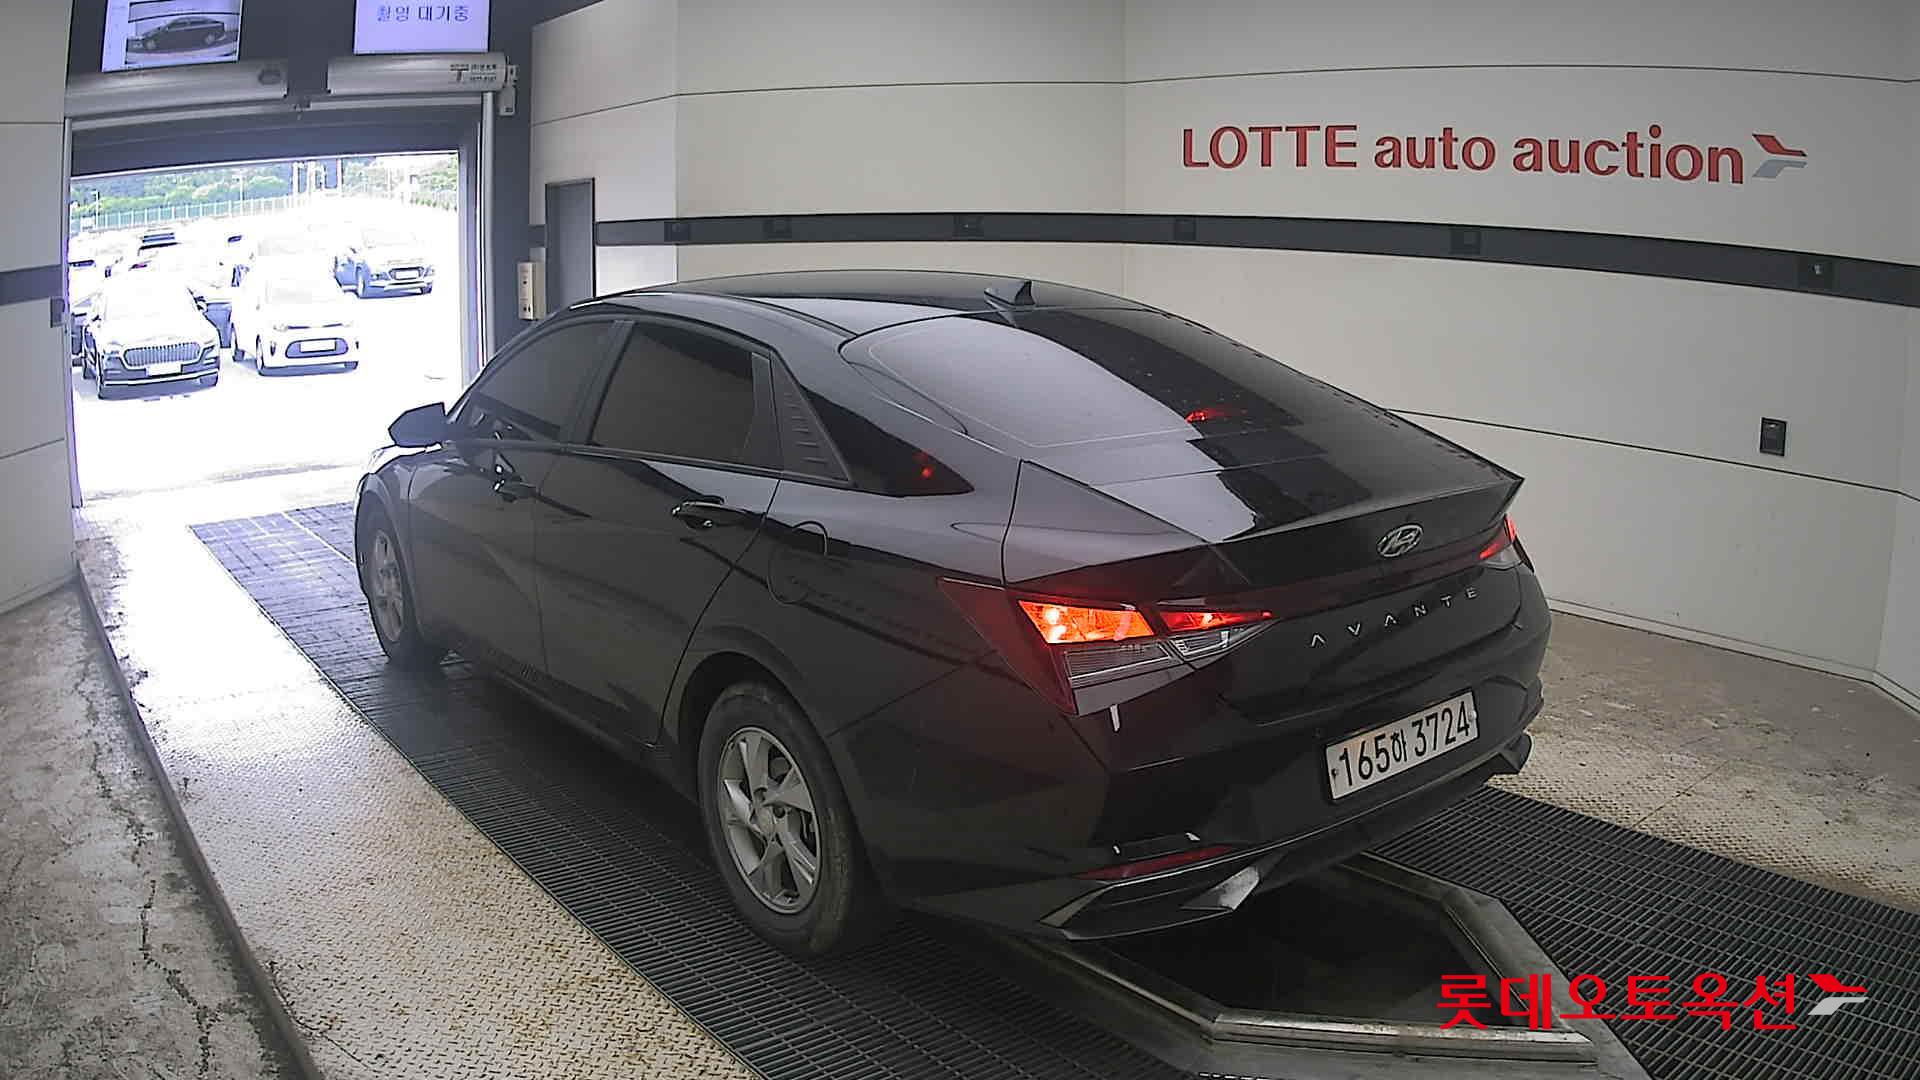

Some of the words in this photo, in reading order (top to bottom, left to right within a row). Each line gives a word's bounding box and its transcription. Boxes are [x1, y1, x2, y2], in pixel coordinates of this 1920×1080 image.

[417, 5, 469, 22] 대기중
[1183, 125, 1358, 168] LOTTE
[1375, 128, 1496, 171] auto
[1514, 125, 1744, 183] auction
[1310, 586, 1479, 648] AVANTE
[1412, 701, 1470, 758] 3724
